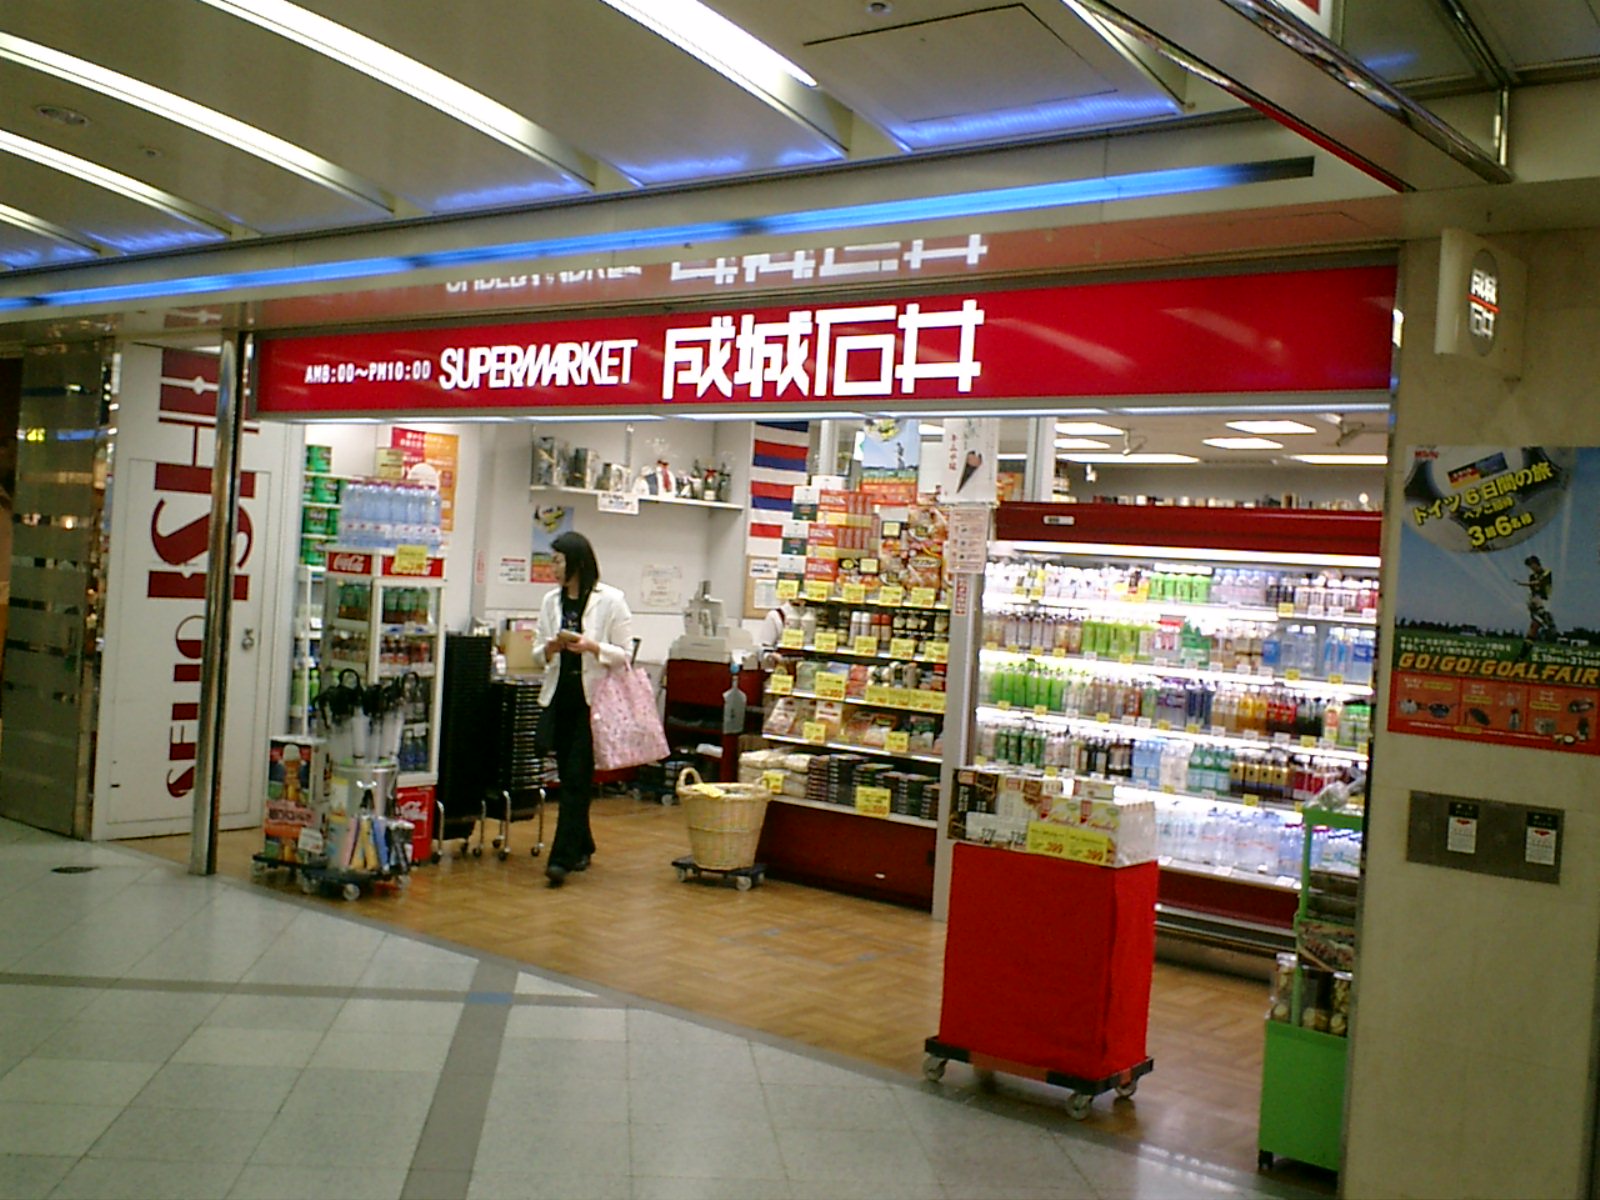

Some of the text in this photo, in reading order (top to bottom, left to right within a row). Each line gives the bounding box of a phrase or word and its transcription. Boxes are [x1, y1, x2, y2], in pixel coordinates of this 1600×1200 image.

[438, 338, 639, 391] SUPERMARKET
[662, 299, 986, 400] 成城石井
